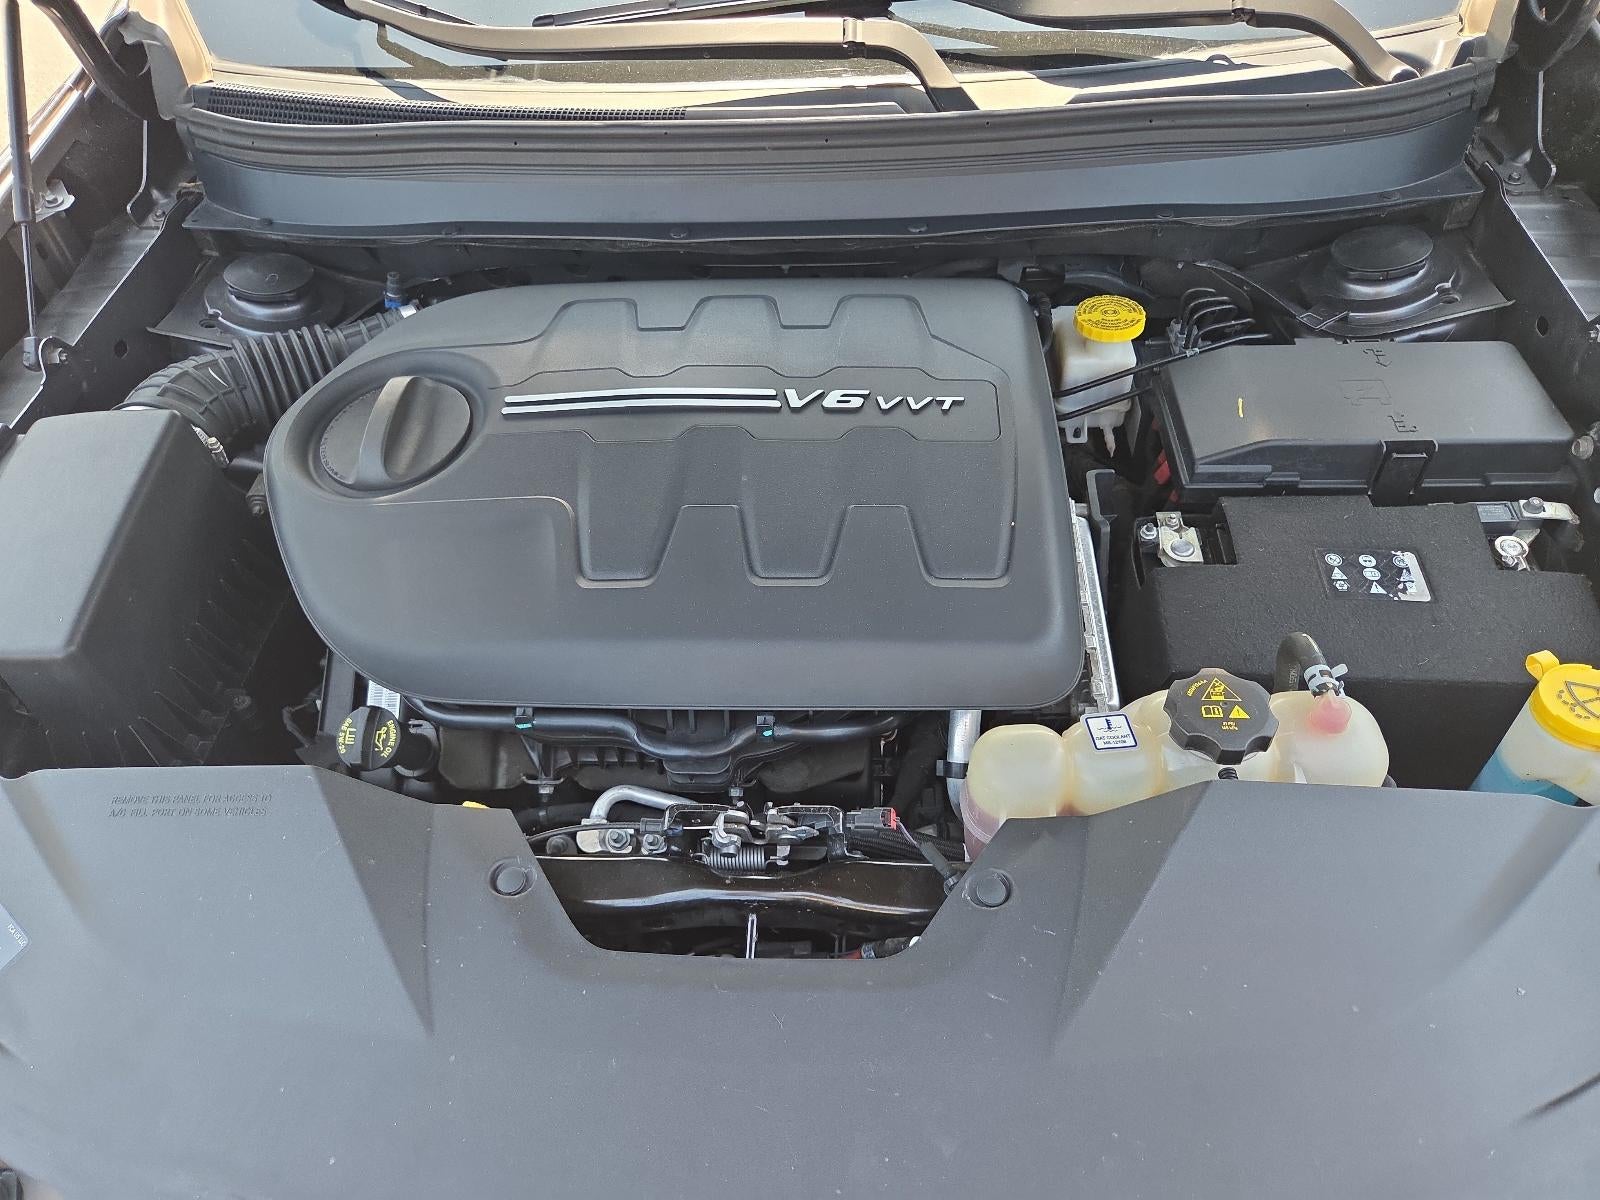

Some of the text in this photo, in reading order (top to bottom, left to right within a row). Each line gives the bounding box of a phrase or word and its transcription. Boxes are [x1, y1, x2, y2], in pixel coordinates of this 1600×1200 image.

[784, 388, 965, 413] V6 VVT
[341, 717, 353, 731] SAE
[380, 719, 397, 758] ENGINE OIL
[111, 793, 272, 805] REMOVE THIS PANEL FOR ACCESS TO
[131, 807, 148, 817] FILL
[152, 807, 176, 817] PORT
[178, 807, 193, 817] ON
[194, 807, 220, 817] SOME
[224, 807, 268, 816] VEHICLES
